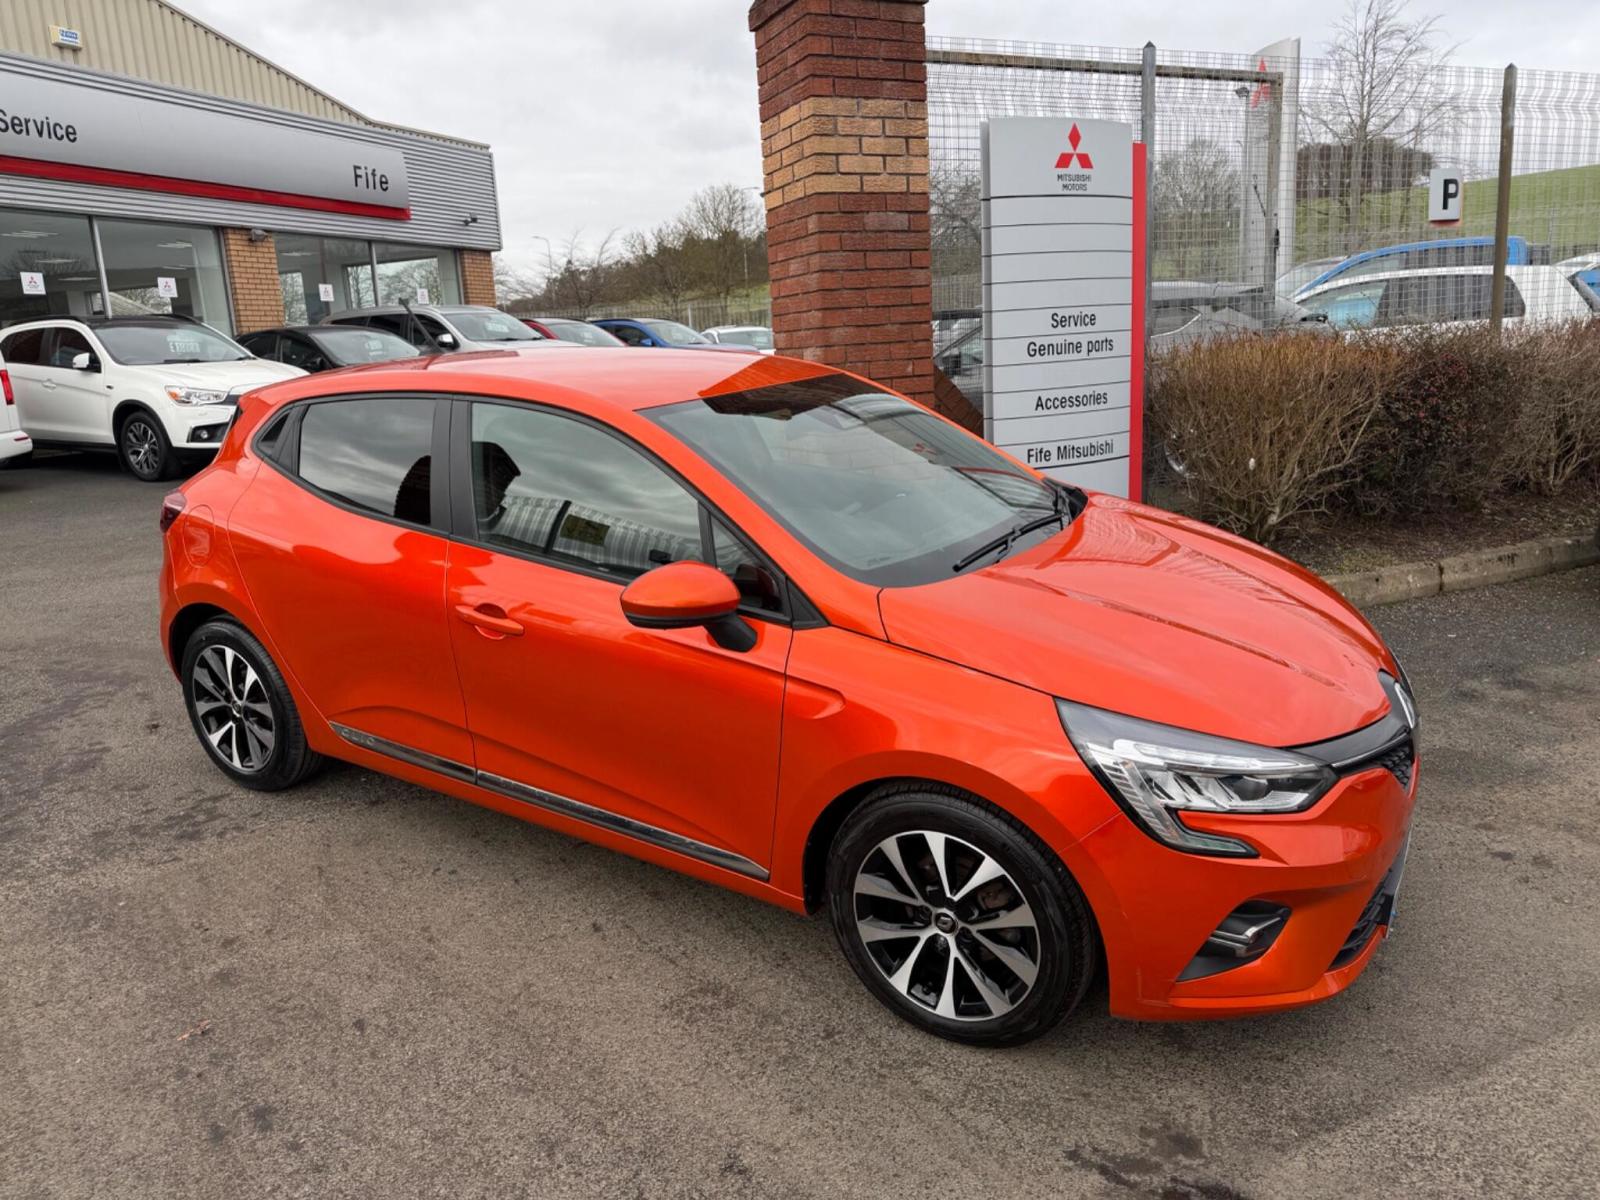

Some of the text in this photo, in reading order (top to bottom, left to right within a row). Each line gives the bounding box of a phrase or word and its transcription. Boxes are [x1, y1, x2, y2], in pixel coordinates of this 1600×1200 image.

[353, 164, 389, 192] Fife
[1057, 173, 1092, 182] MITSUBISHI
[1062, 183, 1088, 191] MOTORS
[1442, 178, 1459, 210] P
[1051, 311, 1096, 329] Service
[1027, 337, 1114, 358] Genuine parts
[1035, 390, 1108, 411] Accessories
[1027, 439, 1114, 464] Fife Mitsubishi
